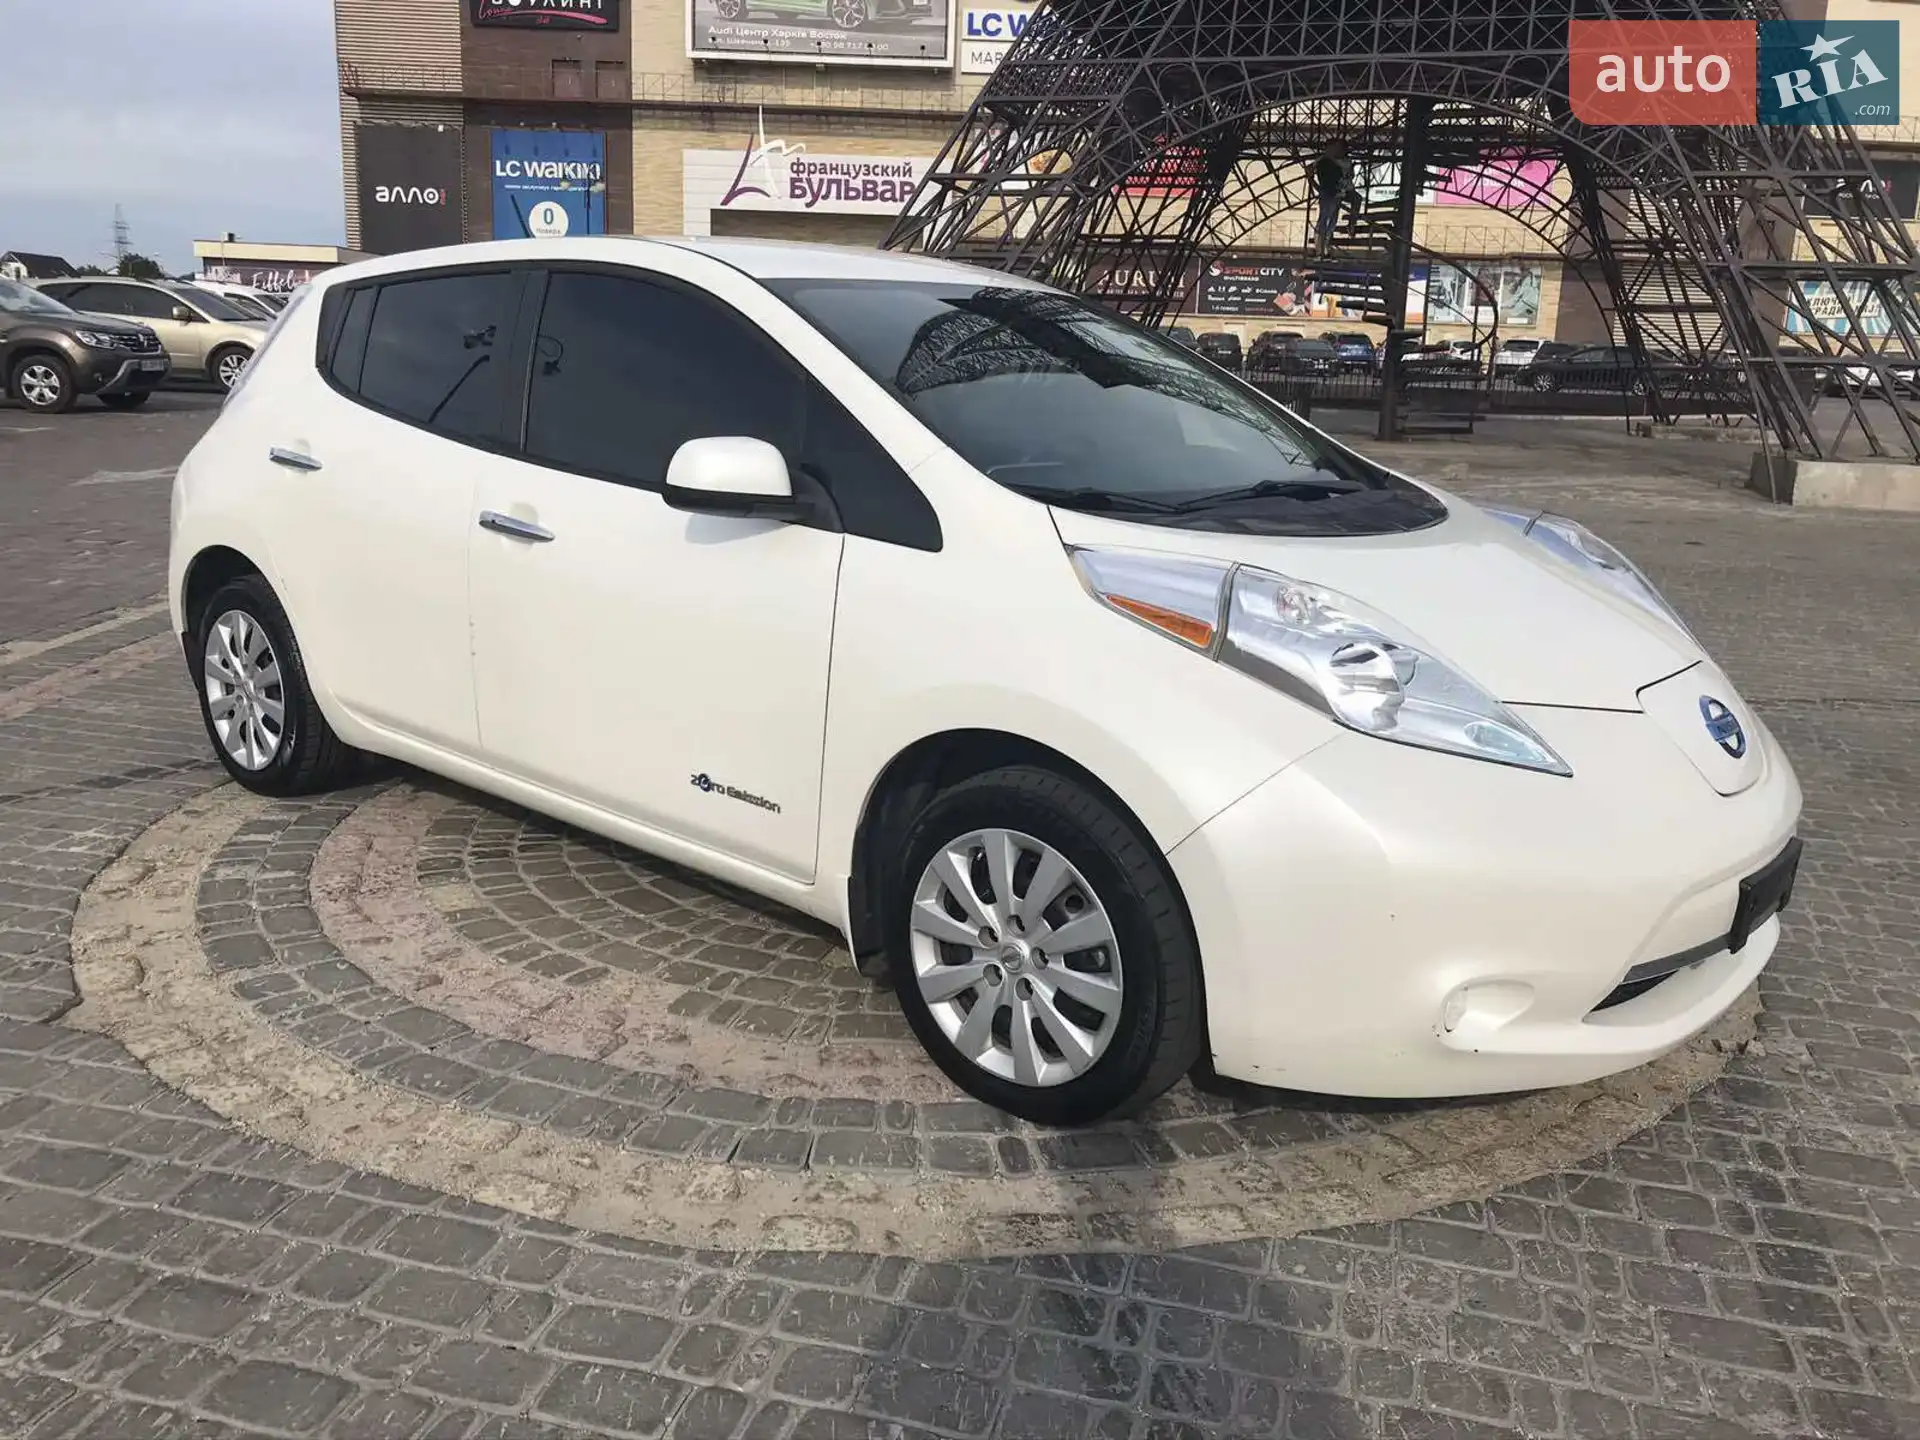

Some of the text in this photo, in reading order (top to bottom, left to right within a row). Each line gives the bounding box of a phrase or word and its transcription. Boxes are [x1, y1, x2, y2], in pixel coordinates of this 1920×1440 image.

[708, 26, 733, 35] Audi
[736, 27, 768, 40] Центр
[967, 12, 1002, 36] LC
[495, 160, 521, 177] LC
[790, 157, 913, 180] французский
